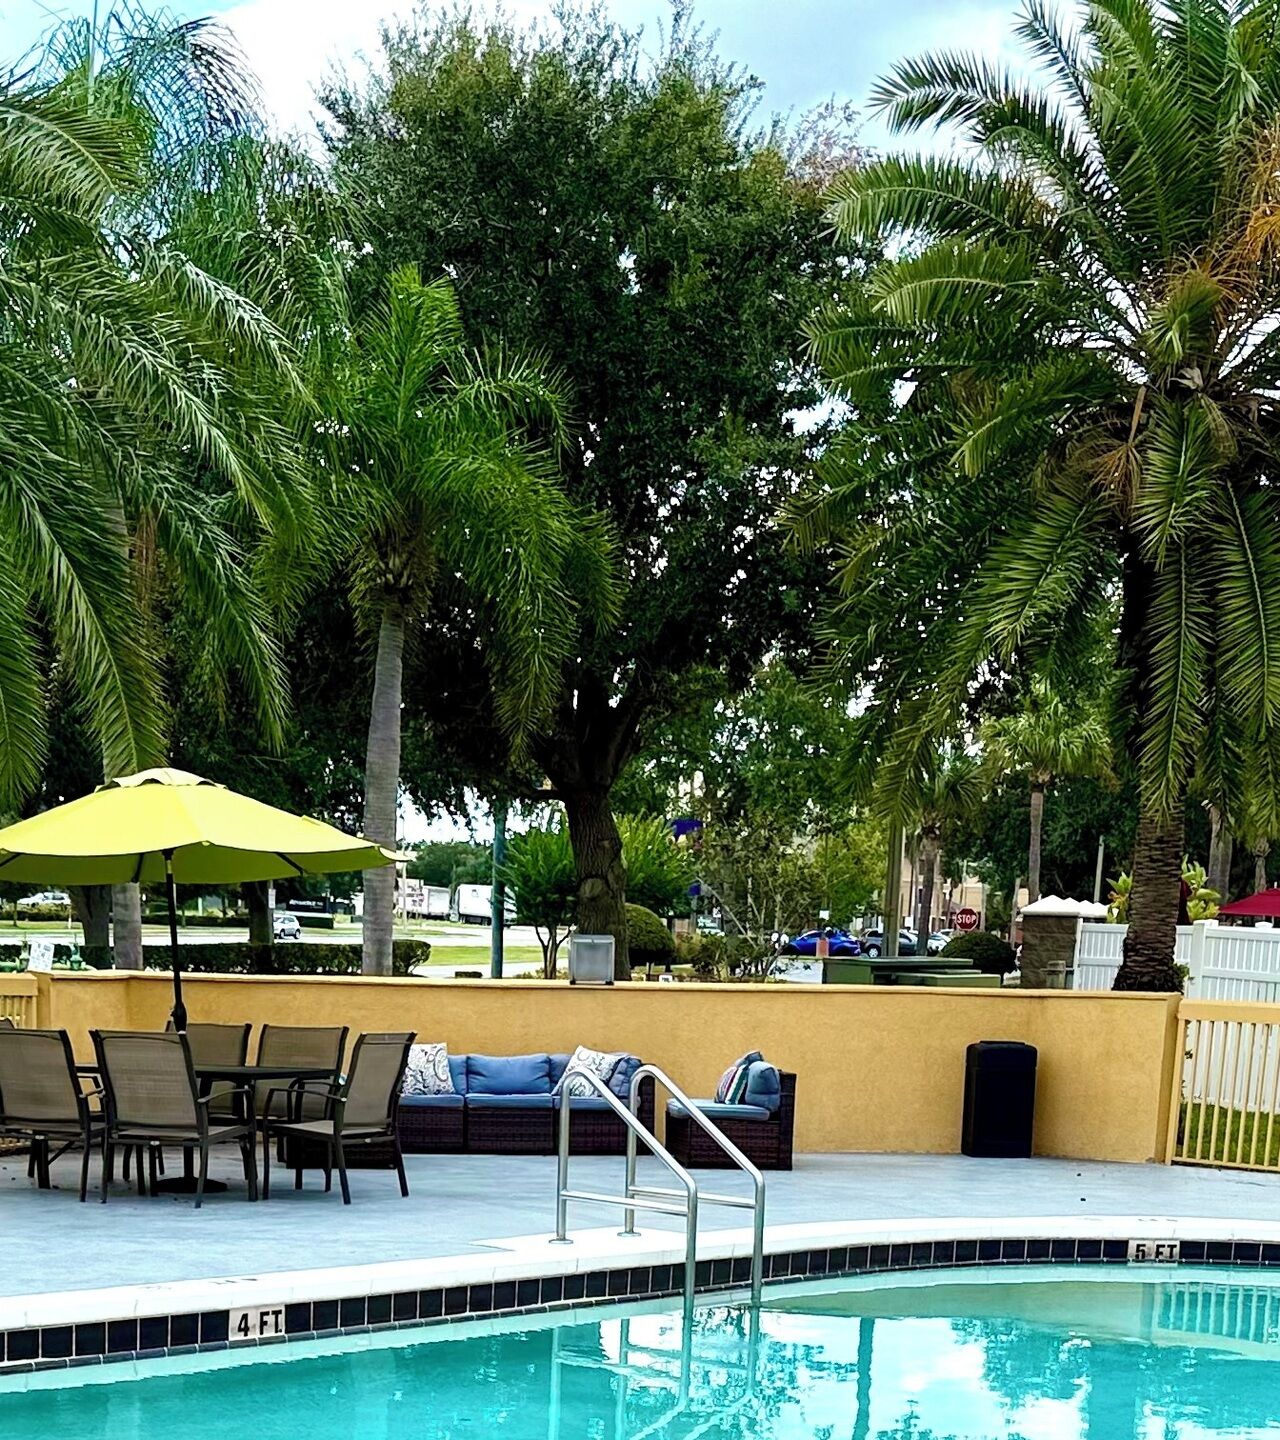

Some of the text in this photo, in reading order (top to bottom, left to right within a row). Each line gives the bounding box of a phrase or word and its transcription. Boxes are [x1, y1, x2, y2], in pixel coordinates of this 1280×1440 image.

[956, 914, 977, 924] STOP
[1135, 1244, 1147, 1260] 5
[237, 1309, 283, 1337] 4 FT.
